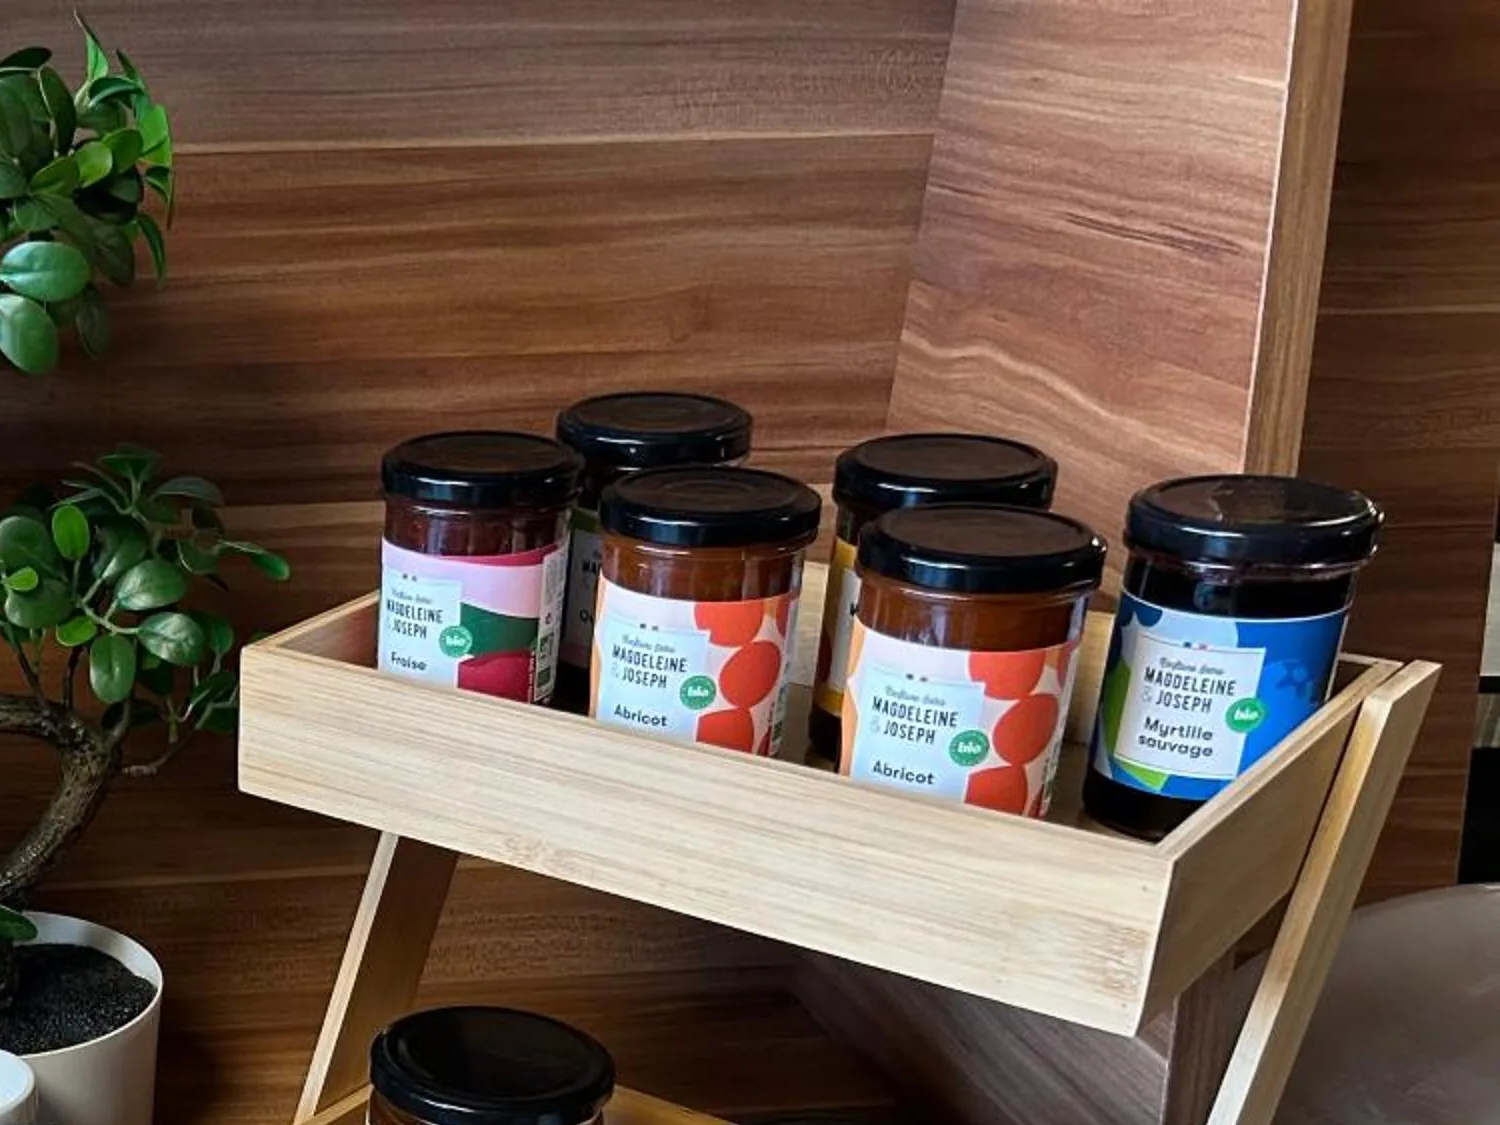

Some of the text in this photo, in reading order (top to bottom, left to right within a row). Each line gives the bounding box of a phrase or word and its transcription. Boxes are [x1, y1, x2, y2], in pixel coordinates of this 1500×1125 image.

[391, 651, 427, 671] Fraise
[622, 667, 667, 689] JOSEPH
[687, 685, 709, 697] bio
[1155, 689, 1213, 714] JOSEPH
[613, 703, 668, 727] Abricot
[1233, 707, 1260, 721] bio
[883, 720, 936, 745] JOSEPH
[1143, 716, 1214, 742] Myrtille
[957, 740, 982, 754] bio
[1138, 735, 1214, 759] sauvage
[872, 759, 936, 785] Abricot
